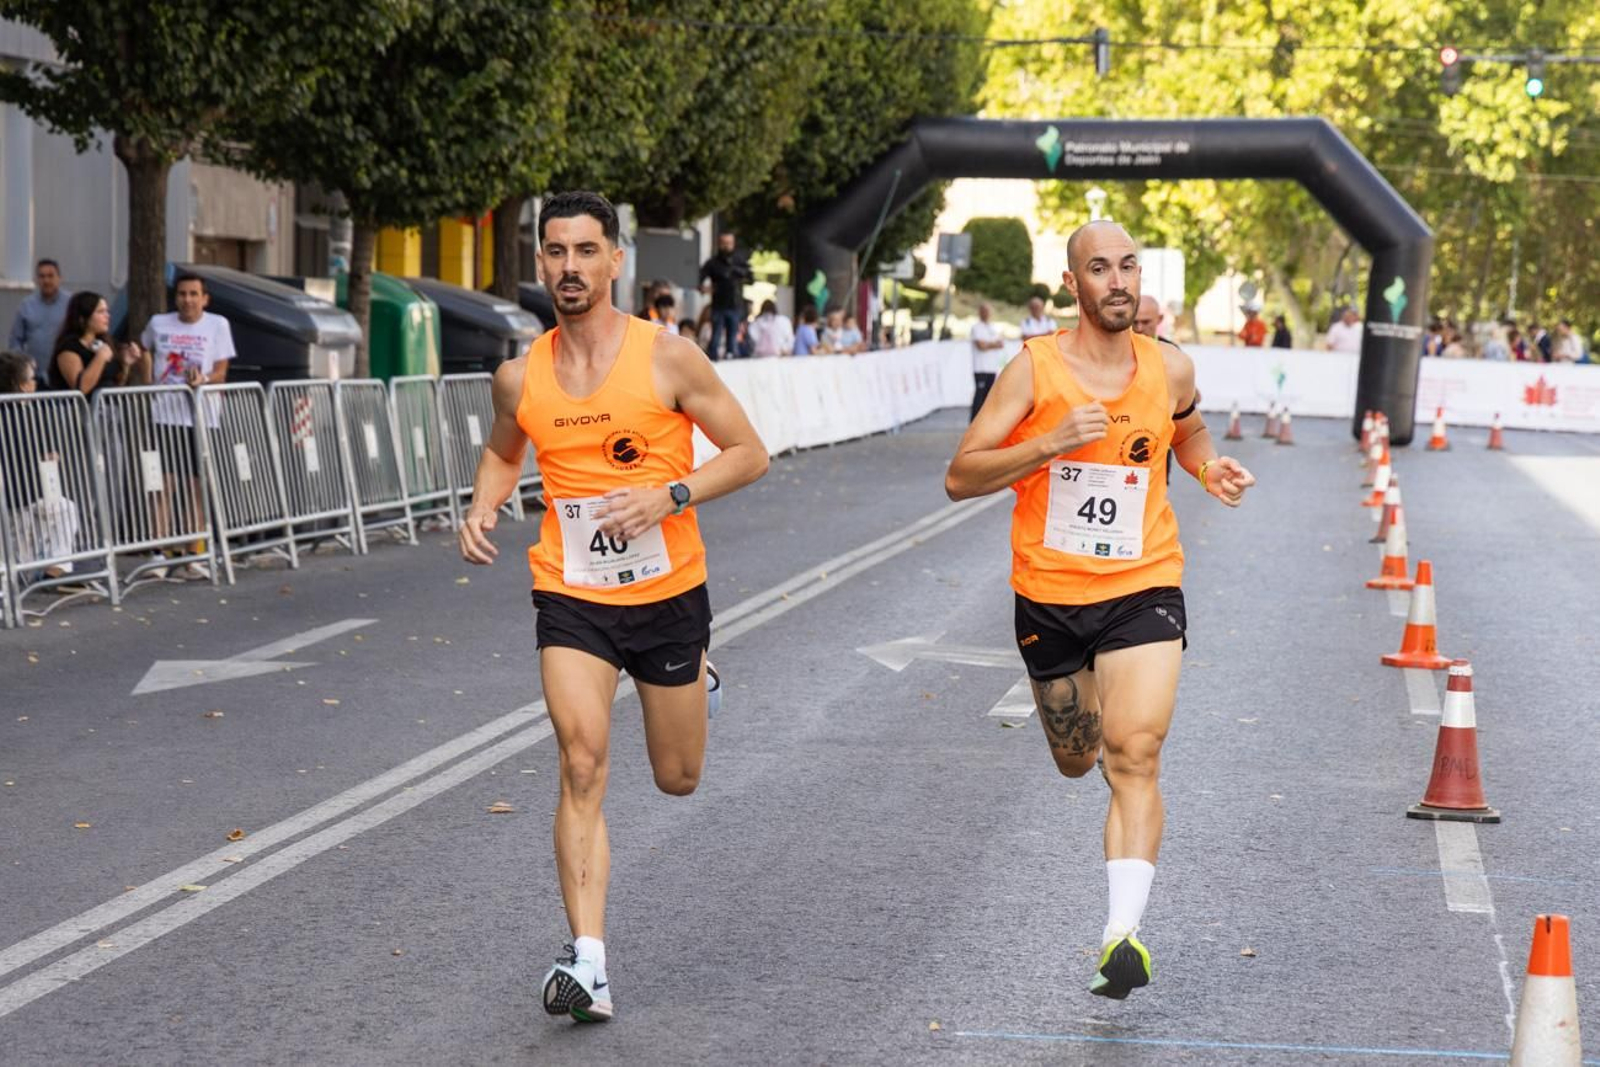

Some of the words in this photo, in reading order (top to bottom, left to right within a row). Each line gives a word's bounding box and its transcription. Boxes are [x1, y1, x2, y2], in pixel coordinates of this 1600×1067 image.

[554, 413, 611, 428] GIVOVA
[1061, 466, 1082, 482] 37
[565, 504, 581, 519] 37
[1077, 496, 1117, 525] 49
